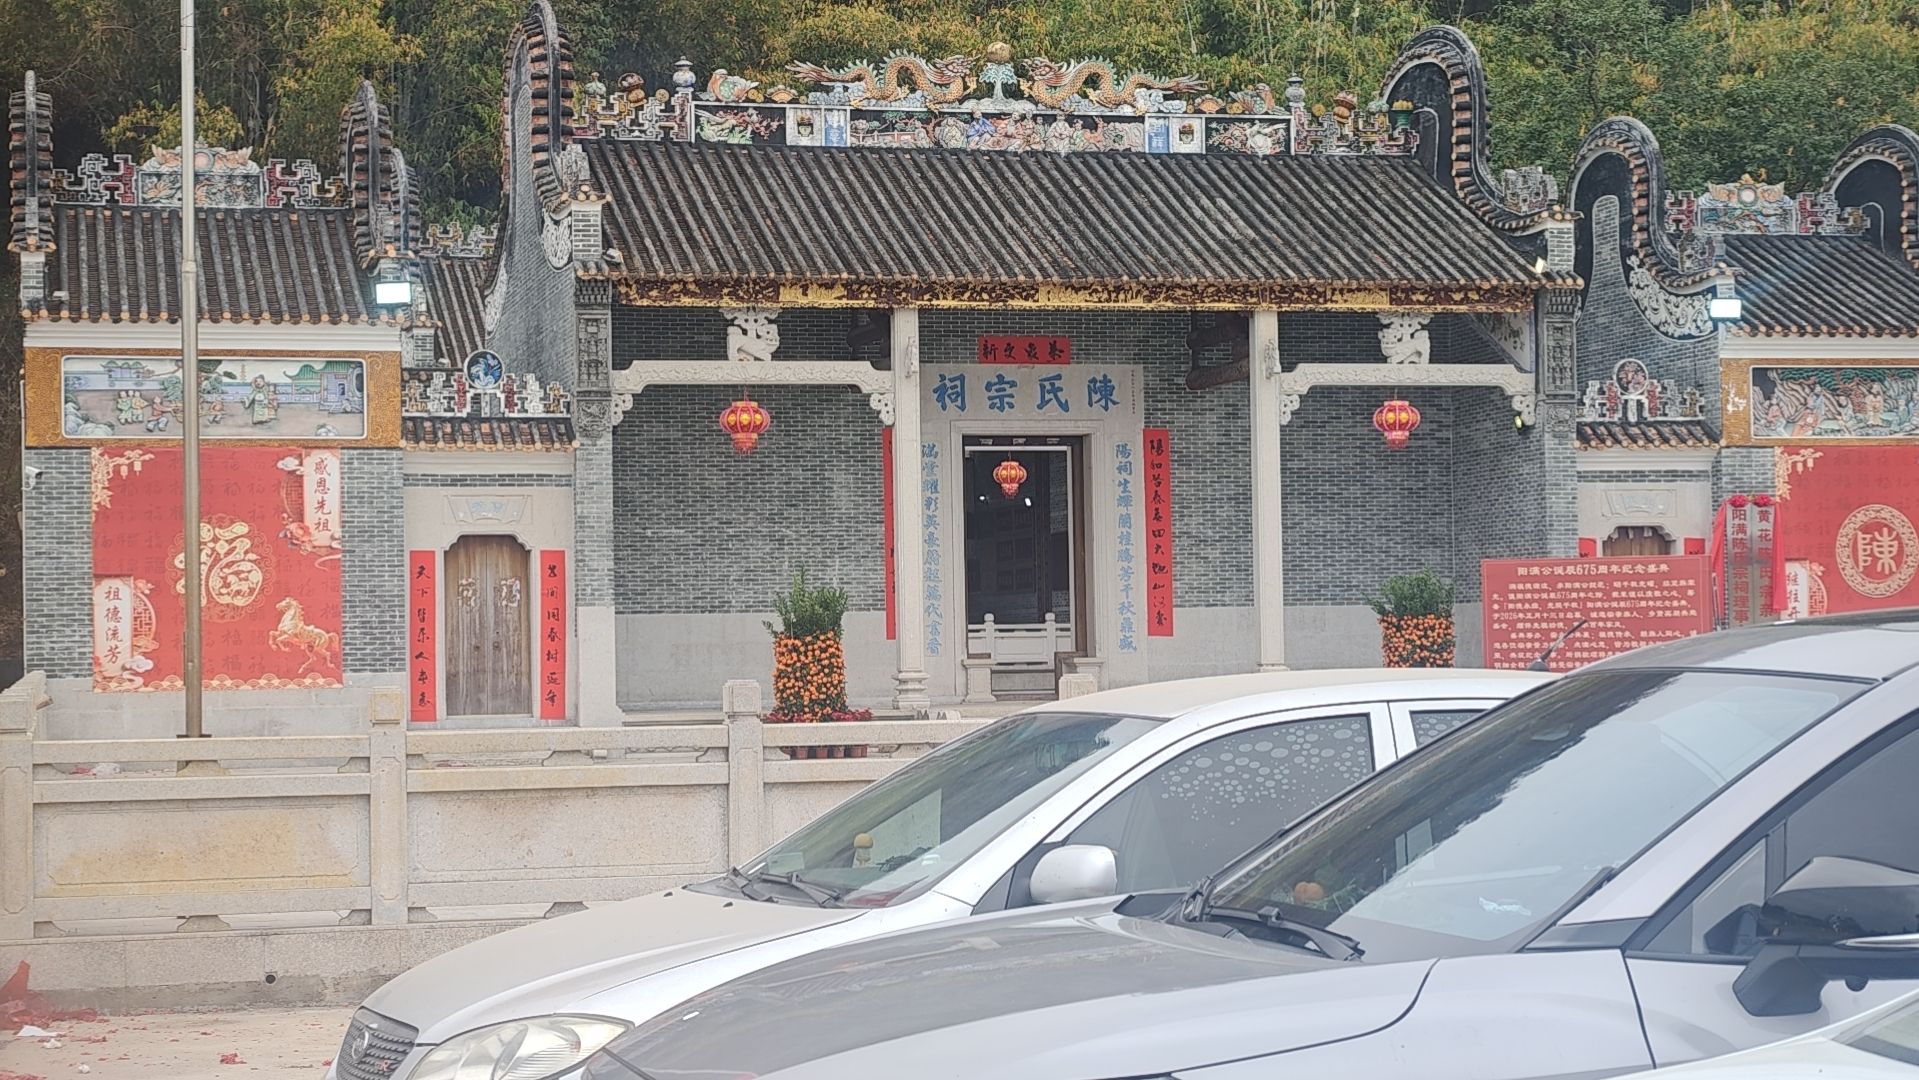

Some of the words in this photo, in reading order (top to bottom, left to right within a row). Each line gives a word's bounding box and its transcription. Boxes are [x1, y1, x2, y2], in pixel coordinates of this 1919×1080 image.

[932, 373, 1121, 413] 陳氏宗祠
[313, 457, 332, 533] 感恩先祖
[104, 586, 123, 665] 祖德流芳
